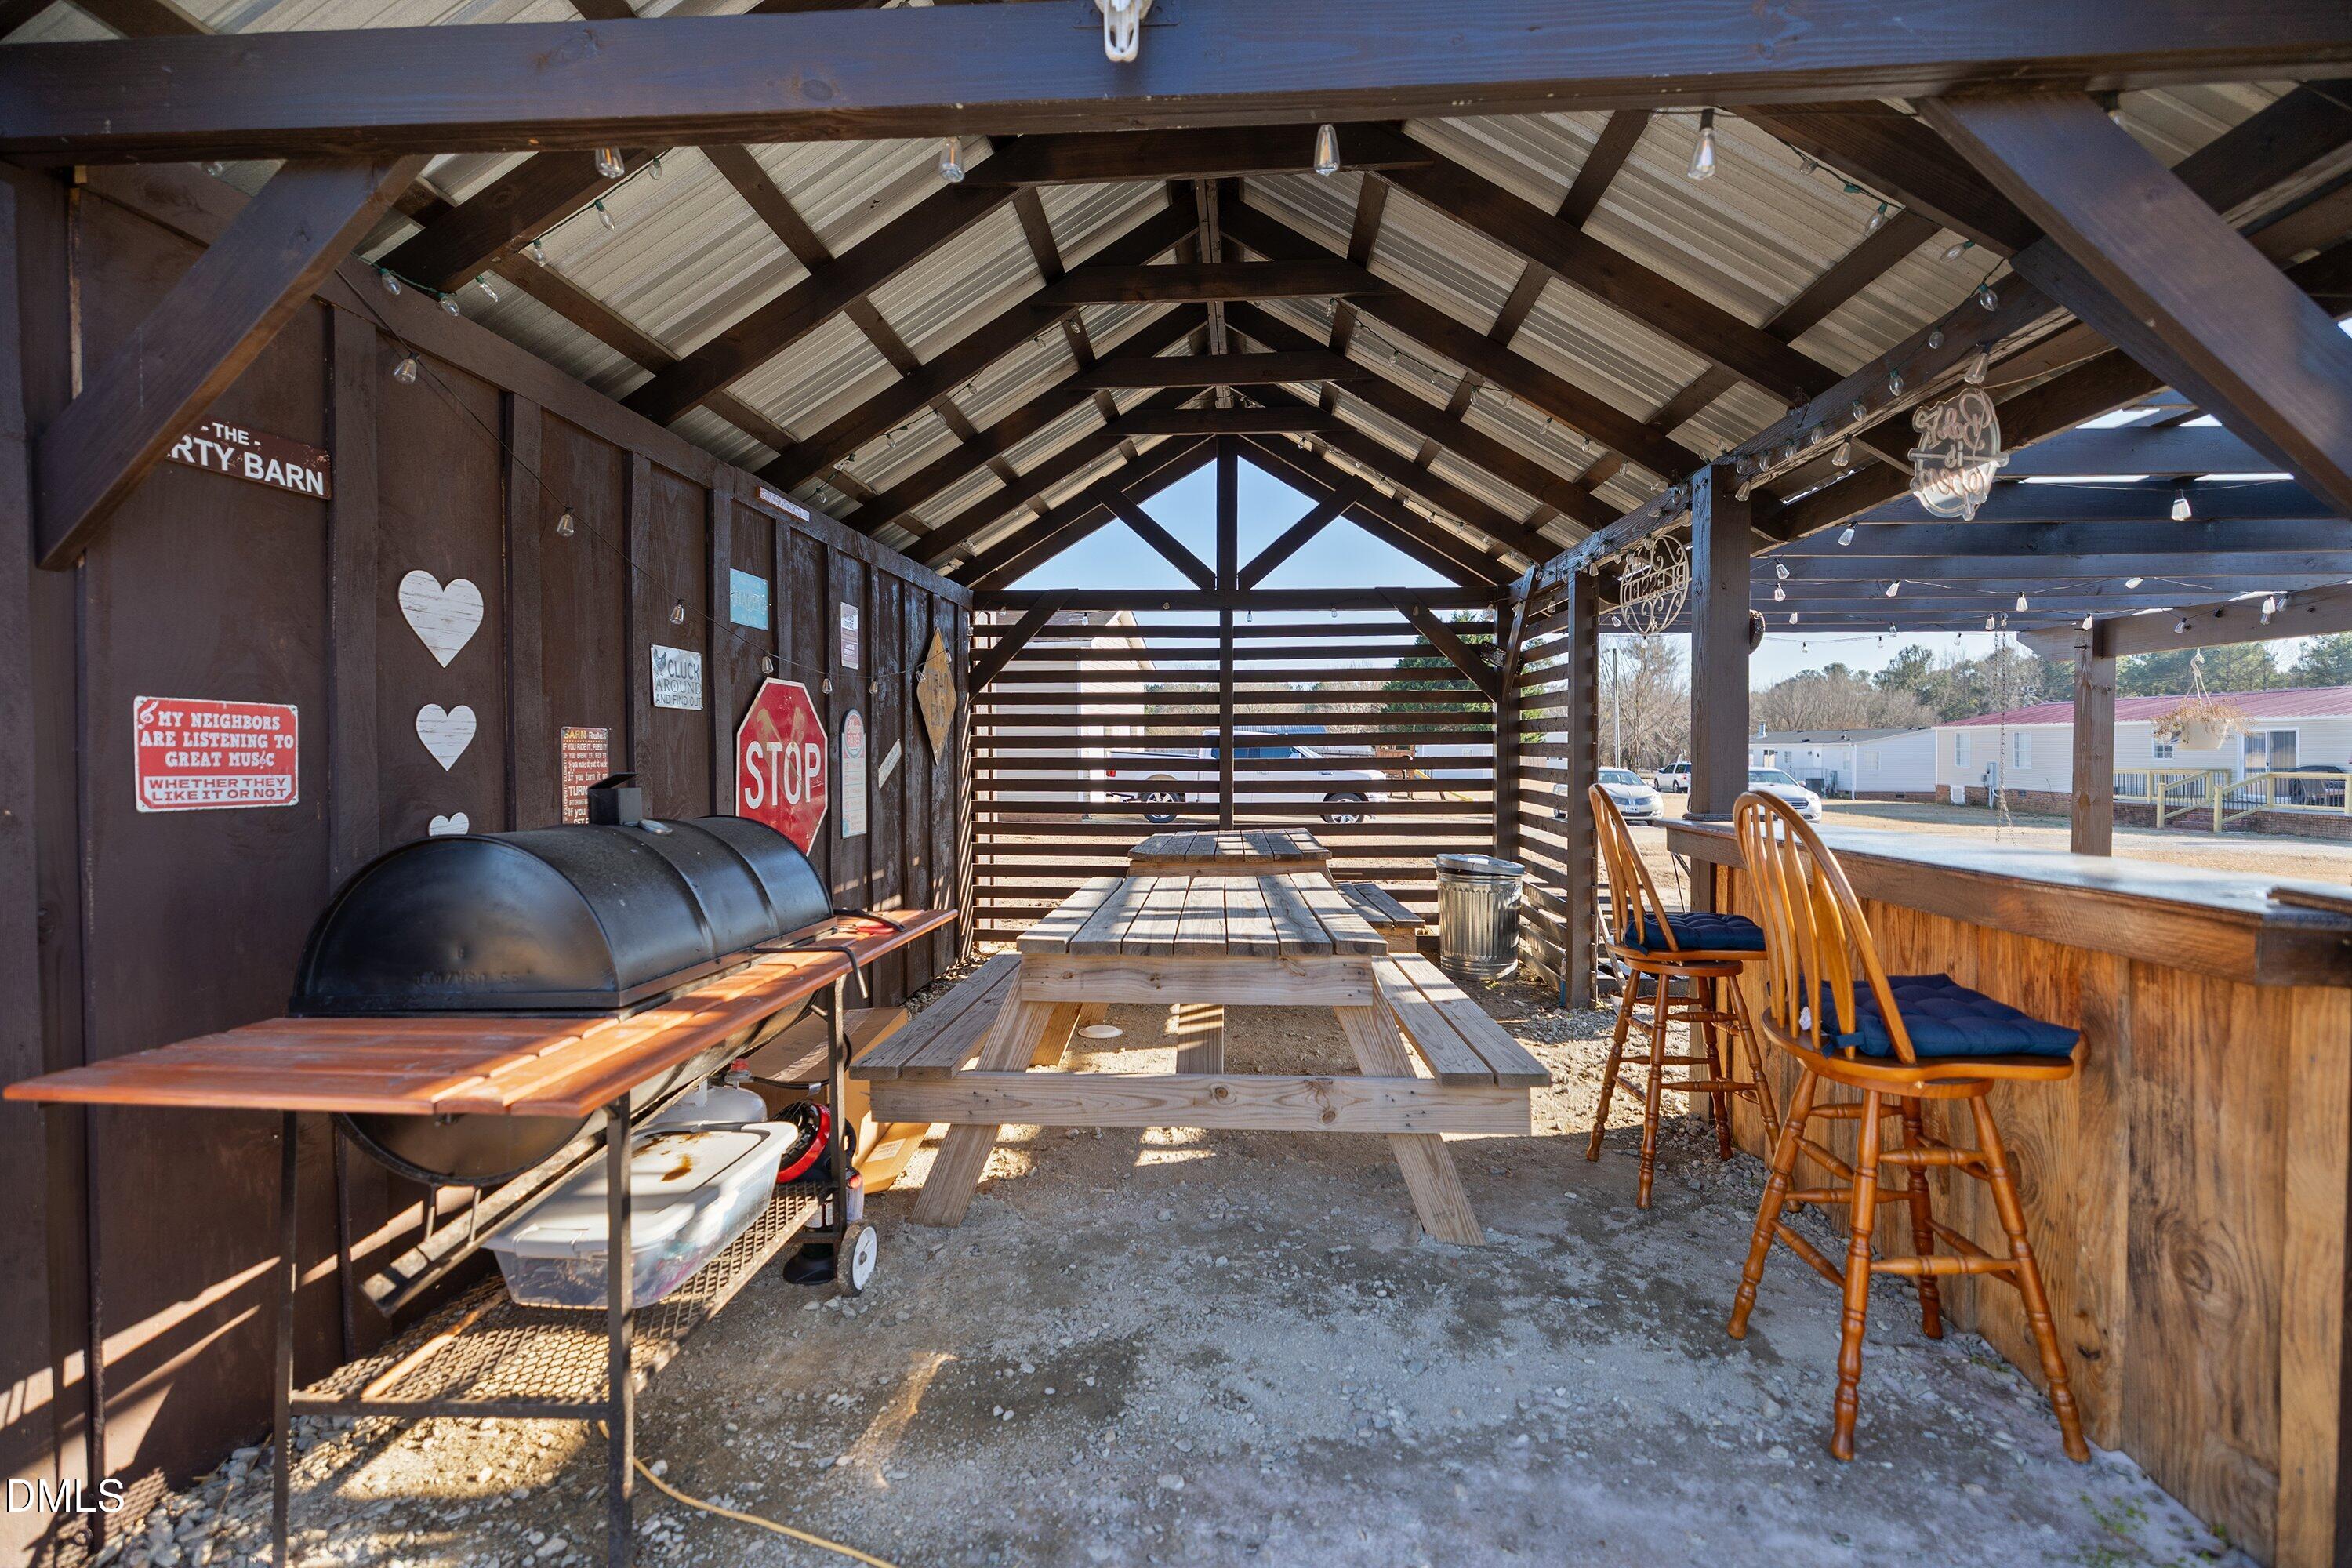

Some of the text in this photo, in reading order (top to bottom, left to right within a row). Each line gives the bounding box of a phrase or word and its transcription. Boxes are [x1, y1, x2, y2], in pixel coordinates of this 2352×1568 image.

[212, 422, 250, 445] THE
[166, 434, 324, 495] RTY BARN
[668, 659, 700, 681] CLUCK
[655, 678, 702, 695] AROUND
[655, 694, 702, 706] AND FIND OUT
[158, 711, 281, 730] MY NEIGHBORS
[140, 731, 294, 749] ARE LISTENING TO
[589, 731, 607, 740] Rules
[165, 750, 223, 768] GREAT
[149, 777, 287, 789] WHETHER THEY
[568, 771, 573, 782] If
[745, 741, 822, 810] STOP
[152, 788, 287, 801] LIKE IT OR NOT
[568, 786, 588, 796] TURN
[568, 808, 586, 818] If you
